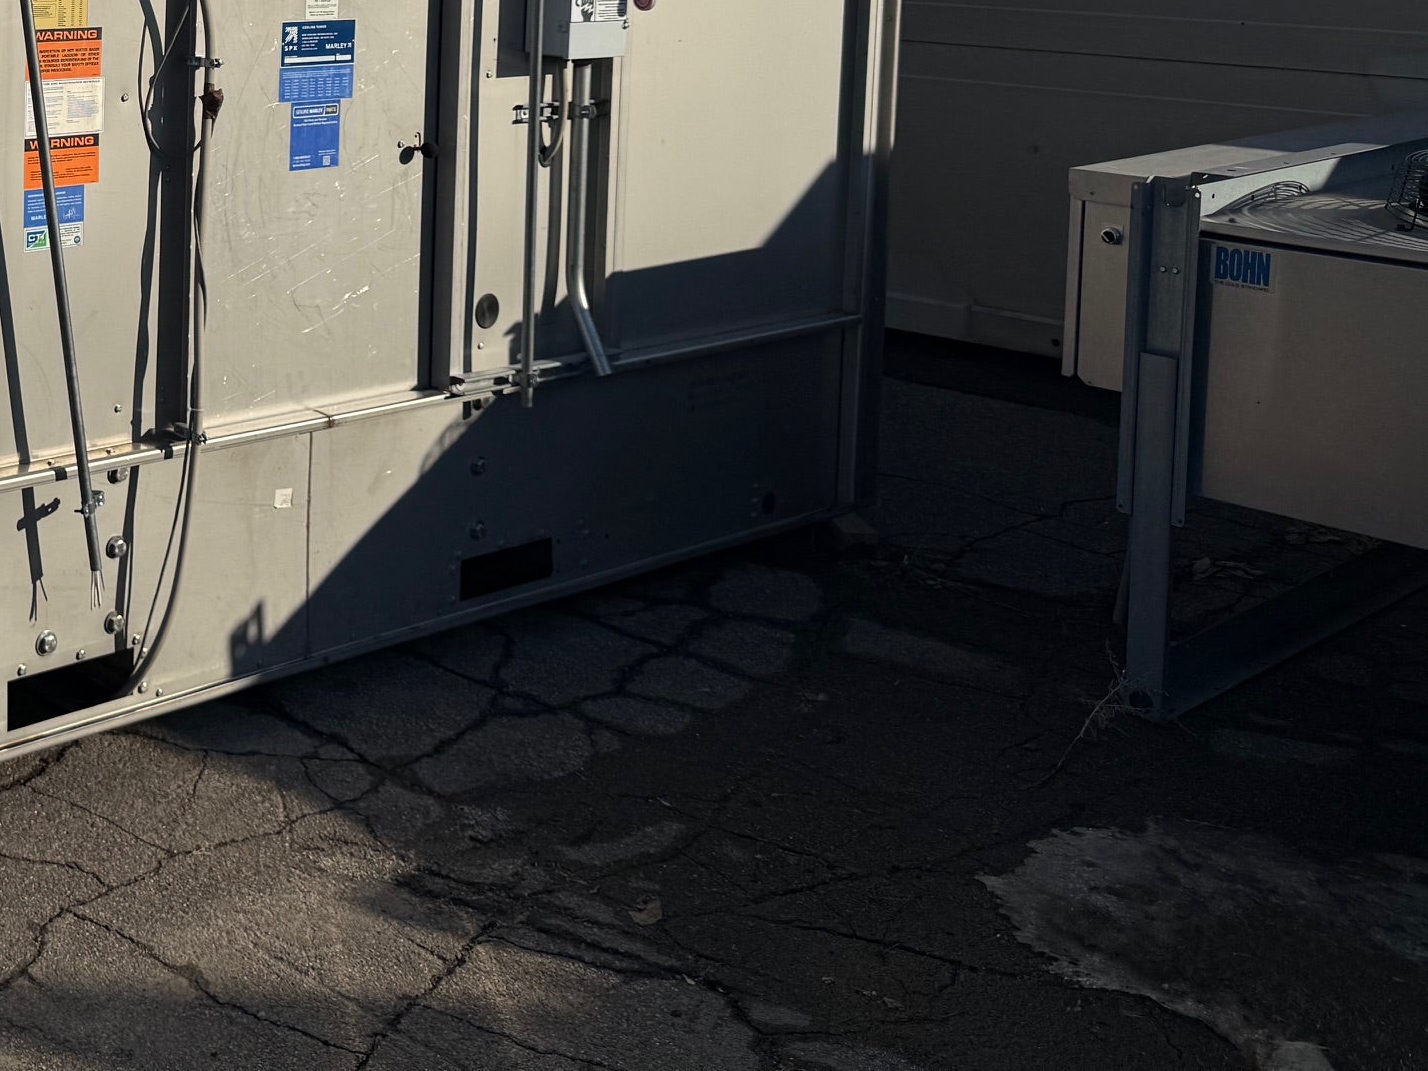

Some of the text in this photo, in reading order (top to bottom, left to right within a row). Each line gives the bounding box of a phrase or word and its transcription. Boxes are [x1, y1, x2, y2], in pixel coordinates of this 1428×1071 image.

[36, 29, 98, 41] WARNING
[29, 136, 94, 149] WRNING
[1214, 245, 1272, 287] BOHN
